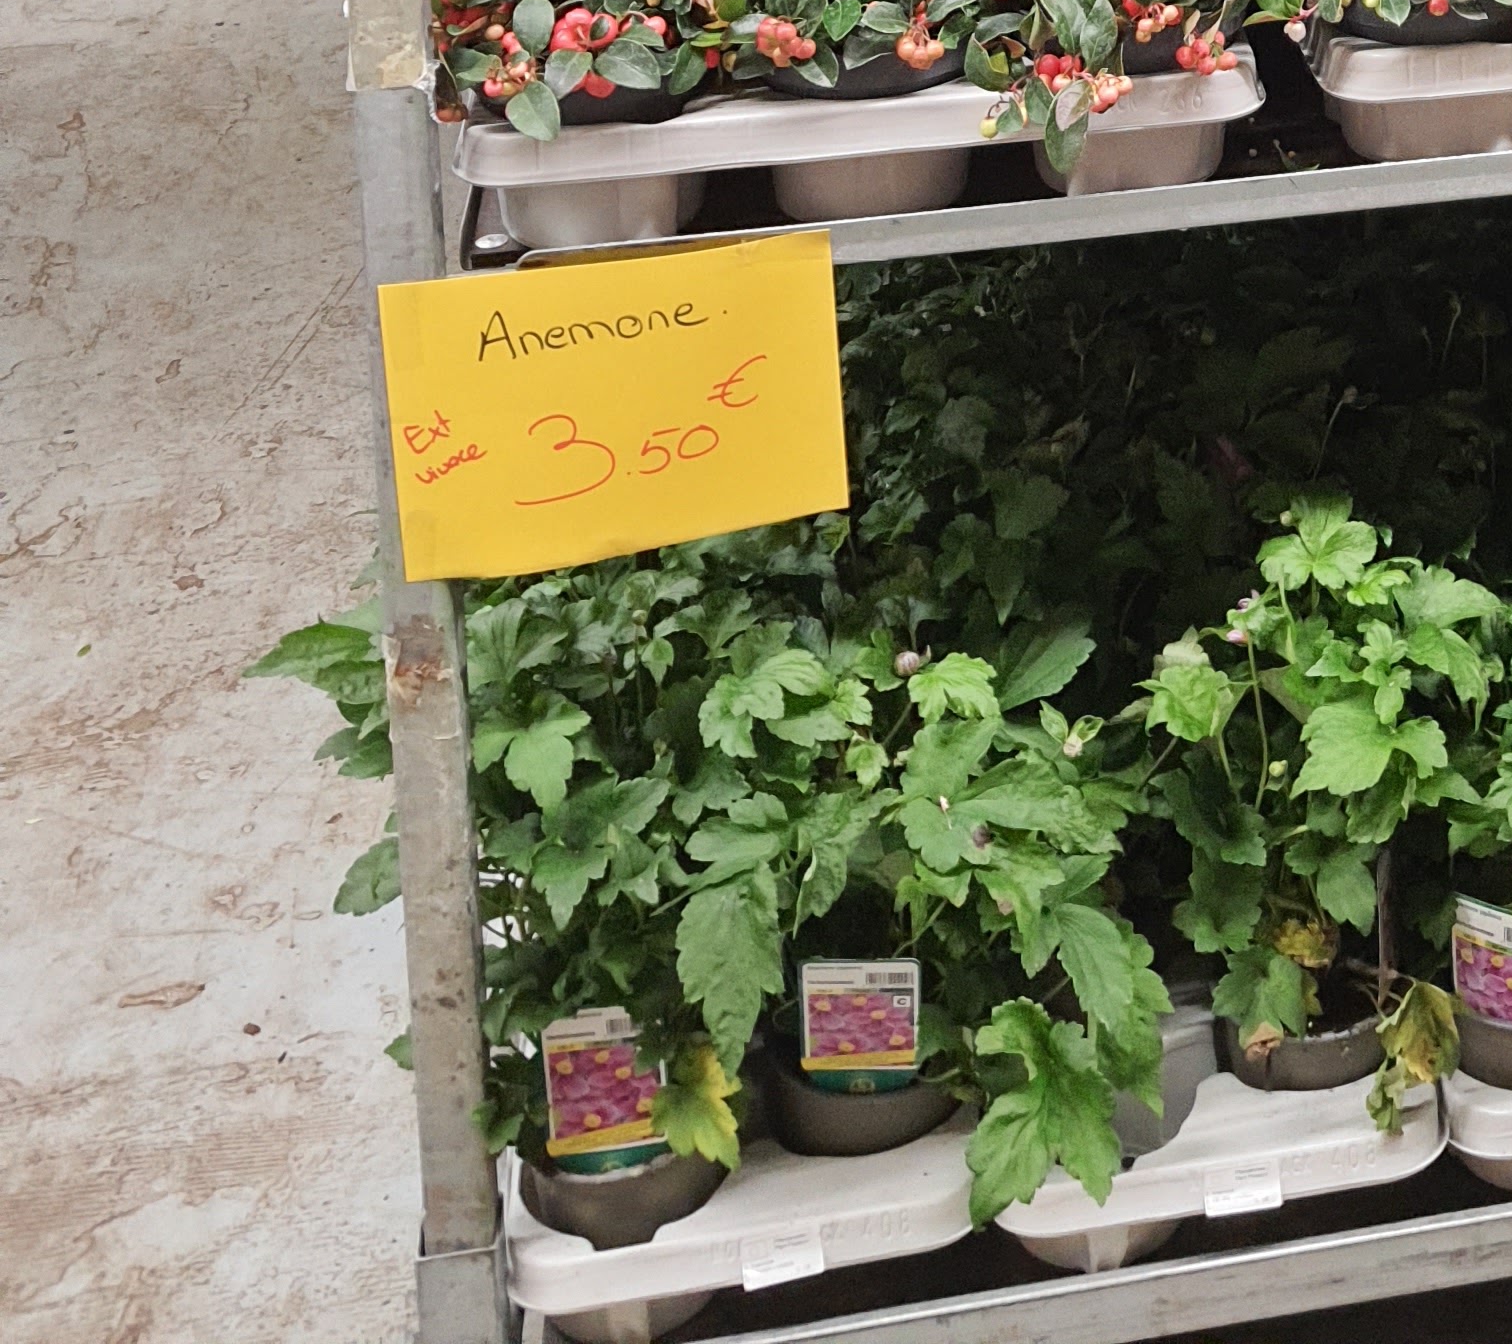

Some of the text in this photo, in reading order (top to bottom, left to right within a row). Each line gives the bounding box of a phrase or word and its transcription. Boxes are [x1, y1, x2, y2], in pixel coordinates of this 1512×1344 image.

[403, 409, 452, 455] Ext
[513, 354, 769, 507] 3.50 €
